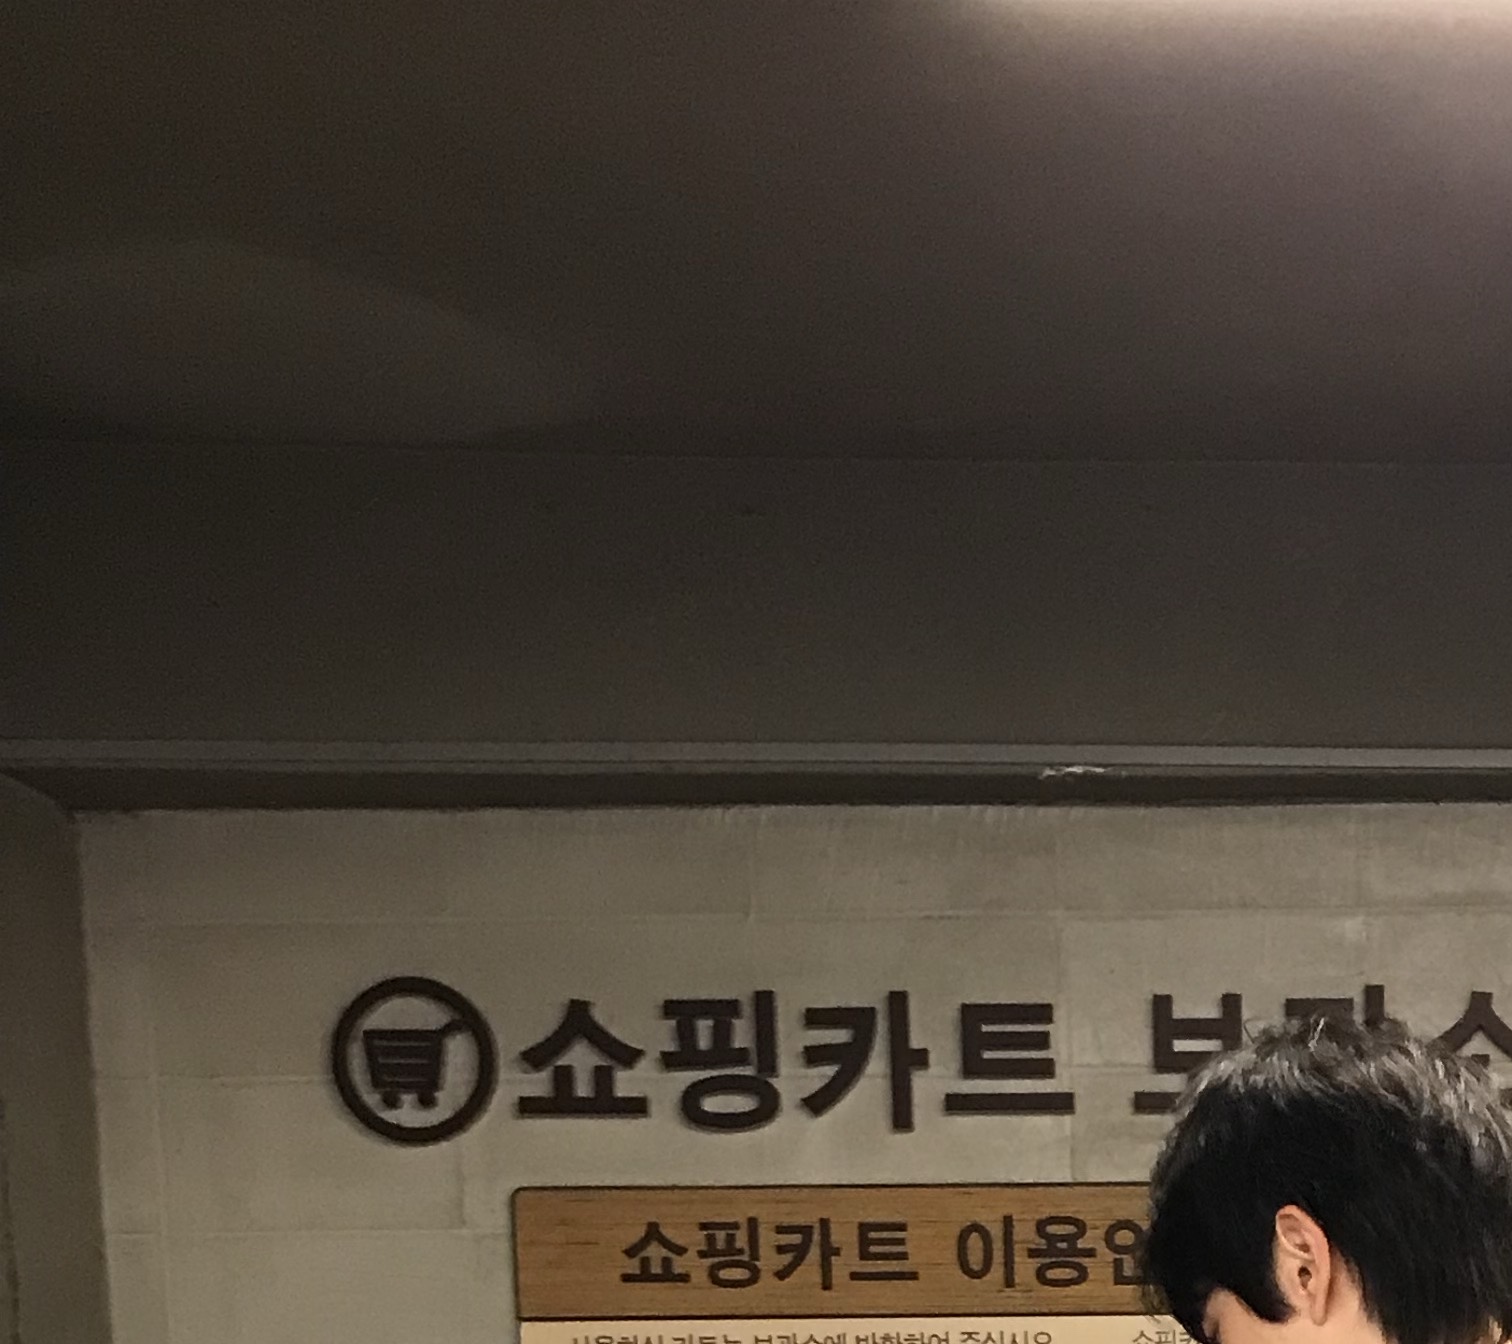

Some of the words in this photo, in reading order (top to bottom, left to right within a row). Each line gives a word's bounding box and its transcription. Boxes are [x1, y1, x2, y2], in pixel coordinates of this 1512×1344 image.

[517, 989, 1076, 1133] 쇼핑카트
[620, 1215, 920, 1291] 쇼핑카트
[956, 1214, 1147, 1290] 이용안
